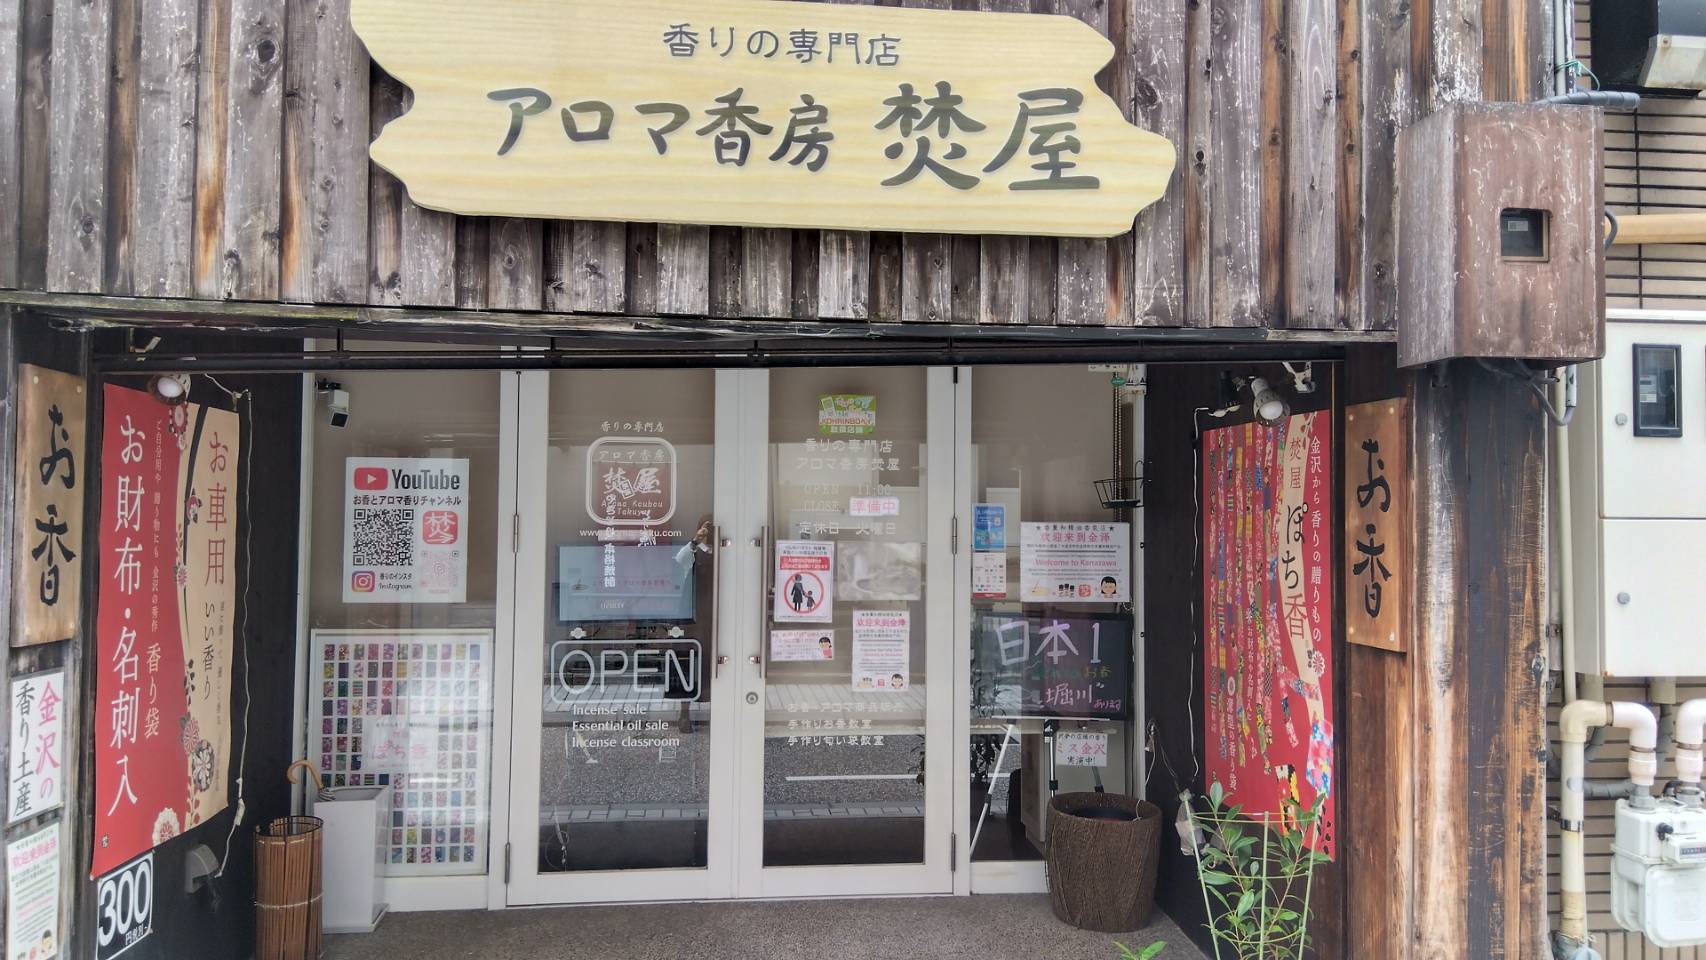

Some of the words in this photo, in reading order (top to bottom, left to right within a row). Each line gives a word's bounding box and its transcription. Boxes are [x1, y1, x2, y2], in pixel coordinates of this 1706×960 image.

[663, 24, 902, 66] 香りの専門店
[487, 87, 833, 170] アロマ香房
[874, 81, 1101, 191] 焚屋
[601, 421, 664, 432] 香りの専門店
[805, 438, 893, 453] 香りの専門店
[32, 404, 76, 606] お香
[205, 431, 228, 586] お車用
[353, 495, 462, 506] お香とアロマ香りチャンネル
[392, 468, 460, 490] YouTube
[852, 500, 896, 513] 準備中
[799, 521, 840, 534] 定休日
[855, 521, 897, 535] 火曜日
[1310, 435, 1322, 642] 金沢から香りの贈りもの
[1352, 438, 1392, 618] お香
[1035, 558, 1070, 567] Welcome
[1071, 558, 1079, 567] to
[1080, 558, 1117, 568] Kanazawa
[1281, 502, 1309, 640] ぽち香
[107, 415, 146, 817] お財布・名刺入
[200, 602, 216, 701] いい香り
[559, 649, 695, 694] OPEN
[144, 642, 161, 738] 香り袋
[573, 704, 618, 715] Incense
[623, 704, 647, 715] sale
[13, 681, 36, 817] 香り土産
[35, 680, 62, 799] 金沢の
[572, 720, 624, 731] Essential
[626, 720, 642, 731] oil
[645, 720, 669, 731] sale
[572, 736, 617, 748] Incense
[621, 736, 680, 747] classroom
[98, 861, 151, 946] 300
